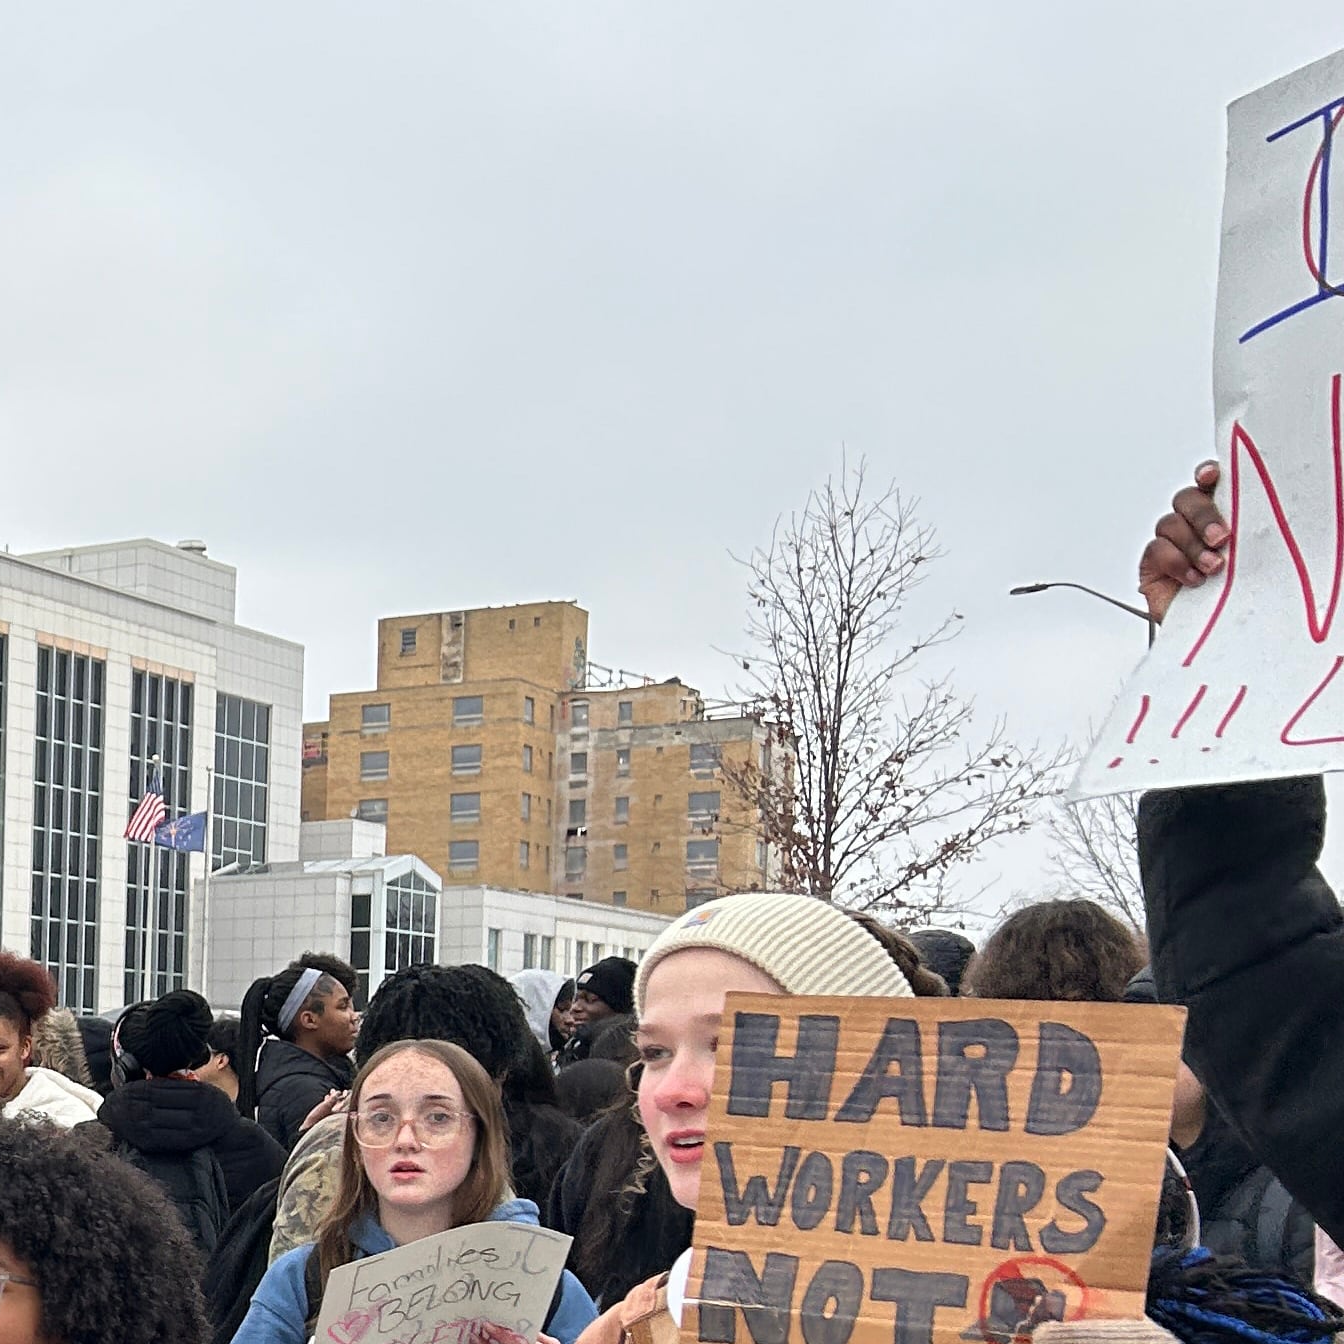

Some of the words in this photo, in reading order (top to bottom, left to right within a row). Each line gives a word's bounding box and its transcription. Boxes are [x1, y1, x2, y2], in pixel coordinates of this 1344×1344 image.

[725, 1010, 1103, 1136] HARD
[713, 1141, 1107, 1254] WORKERS
[377, 1277, 522, 1333] BELONG
